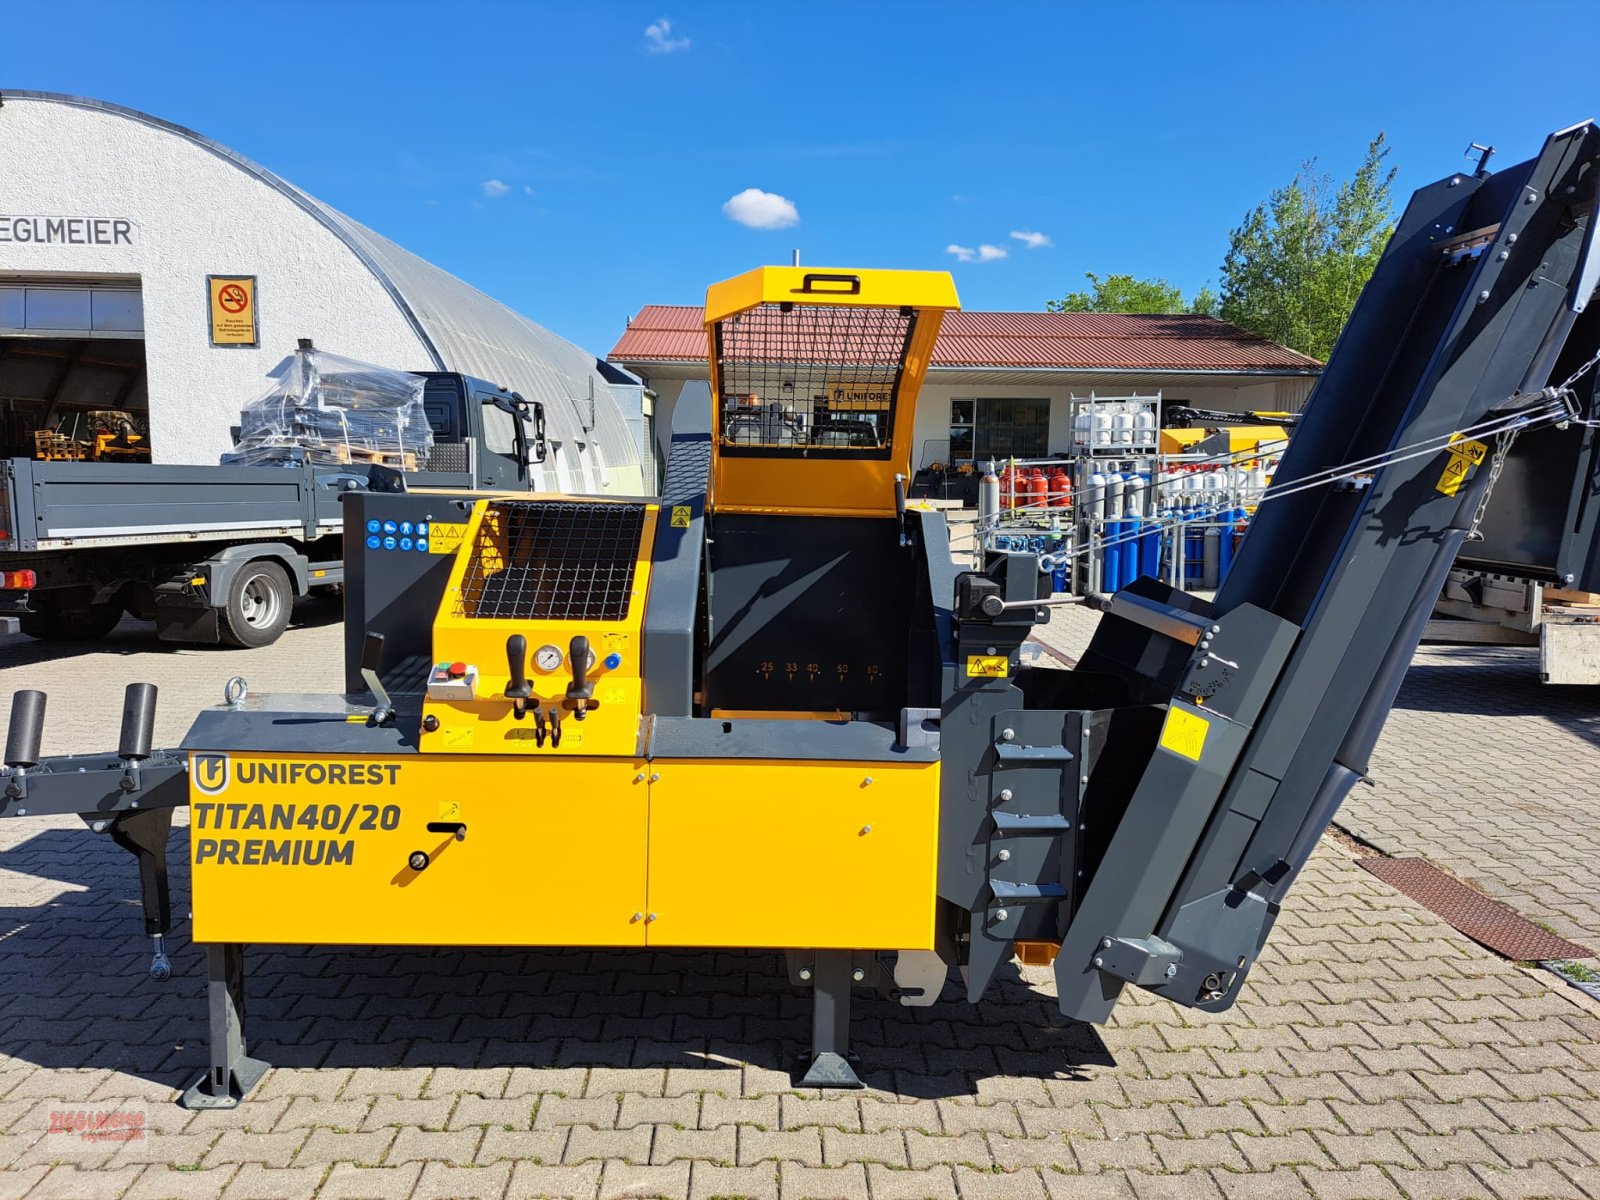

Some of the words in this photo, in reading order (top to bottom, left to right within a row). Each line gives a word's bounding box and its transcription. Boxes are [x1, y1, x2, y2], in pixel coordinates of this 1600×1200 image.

[846, 392, 891, 401] UNIFORE
[761, 662, 774, 672] 25
[785, 662, 798, 672] 33
[806, 663, 819, 673] 40
[836, 664, 849, 673] 50
[236, 762, 402, 785] UNIFOREST
[195, 838, 355, 866] PREMIUM
